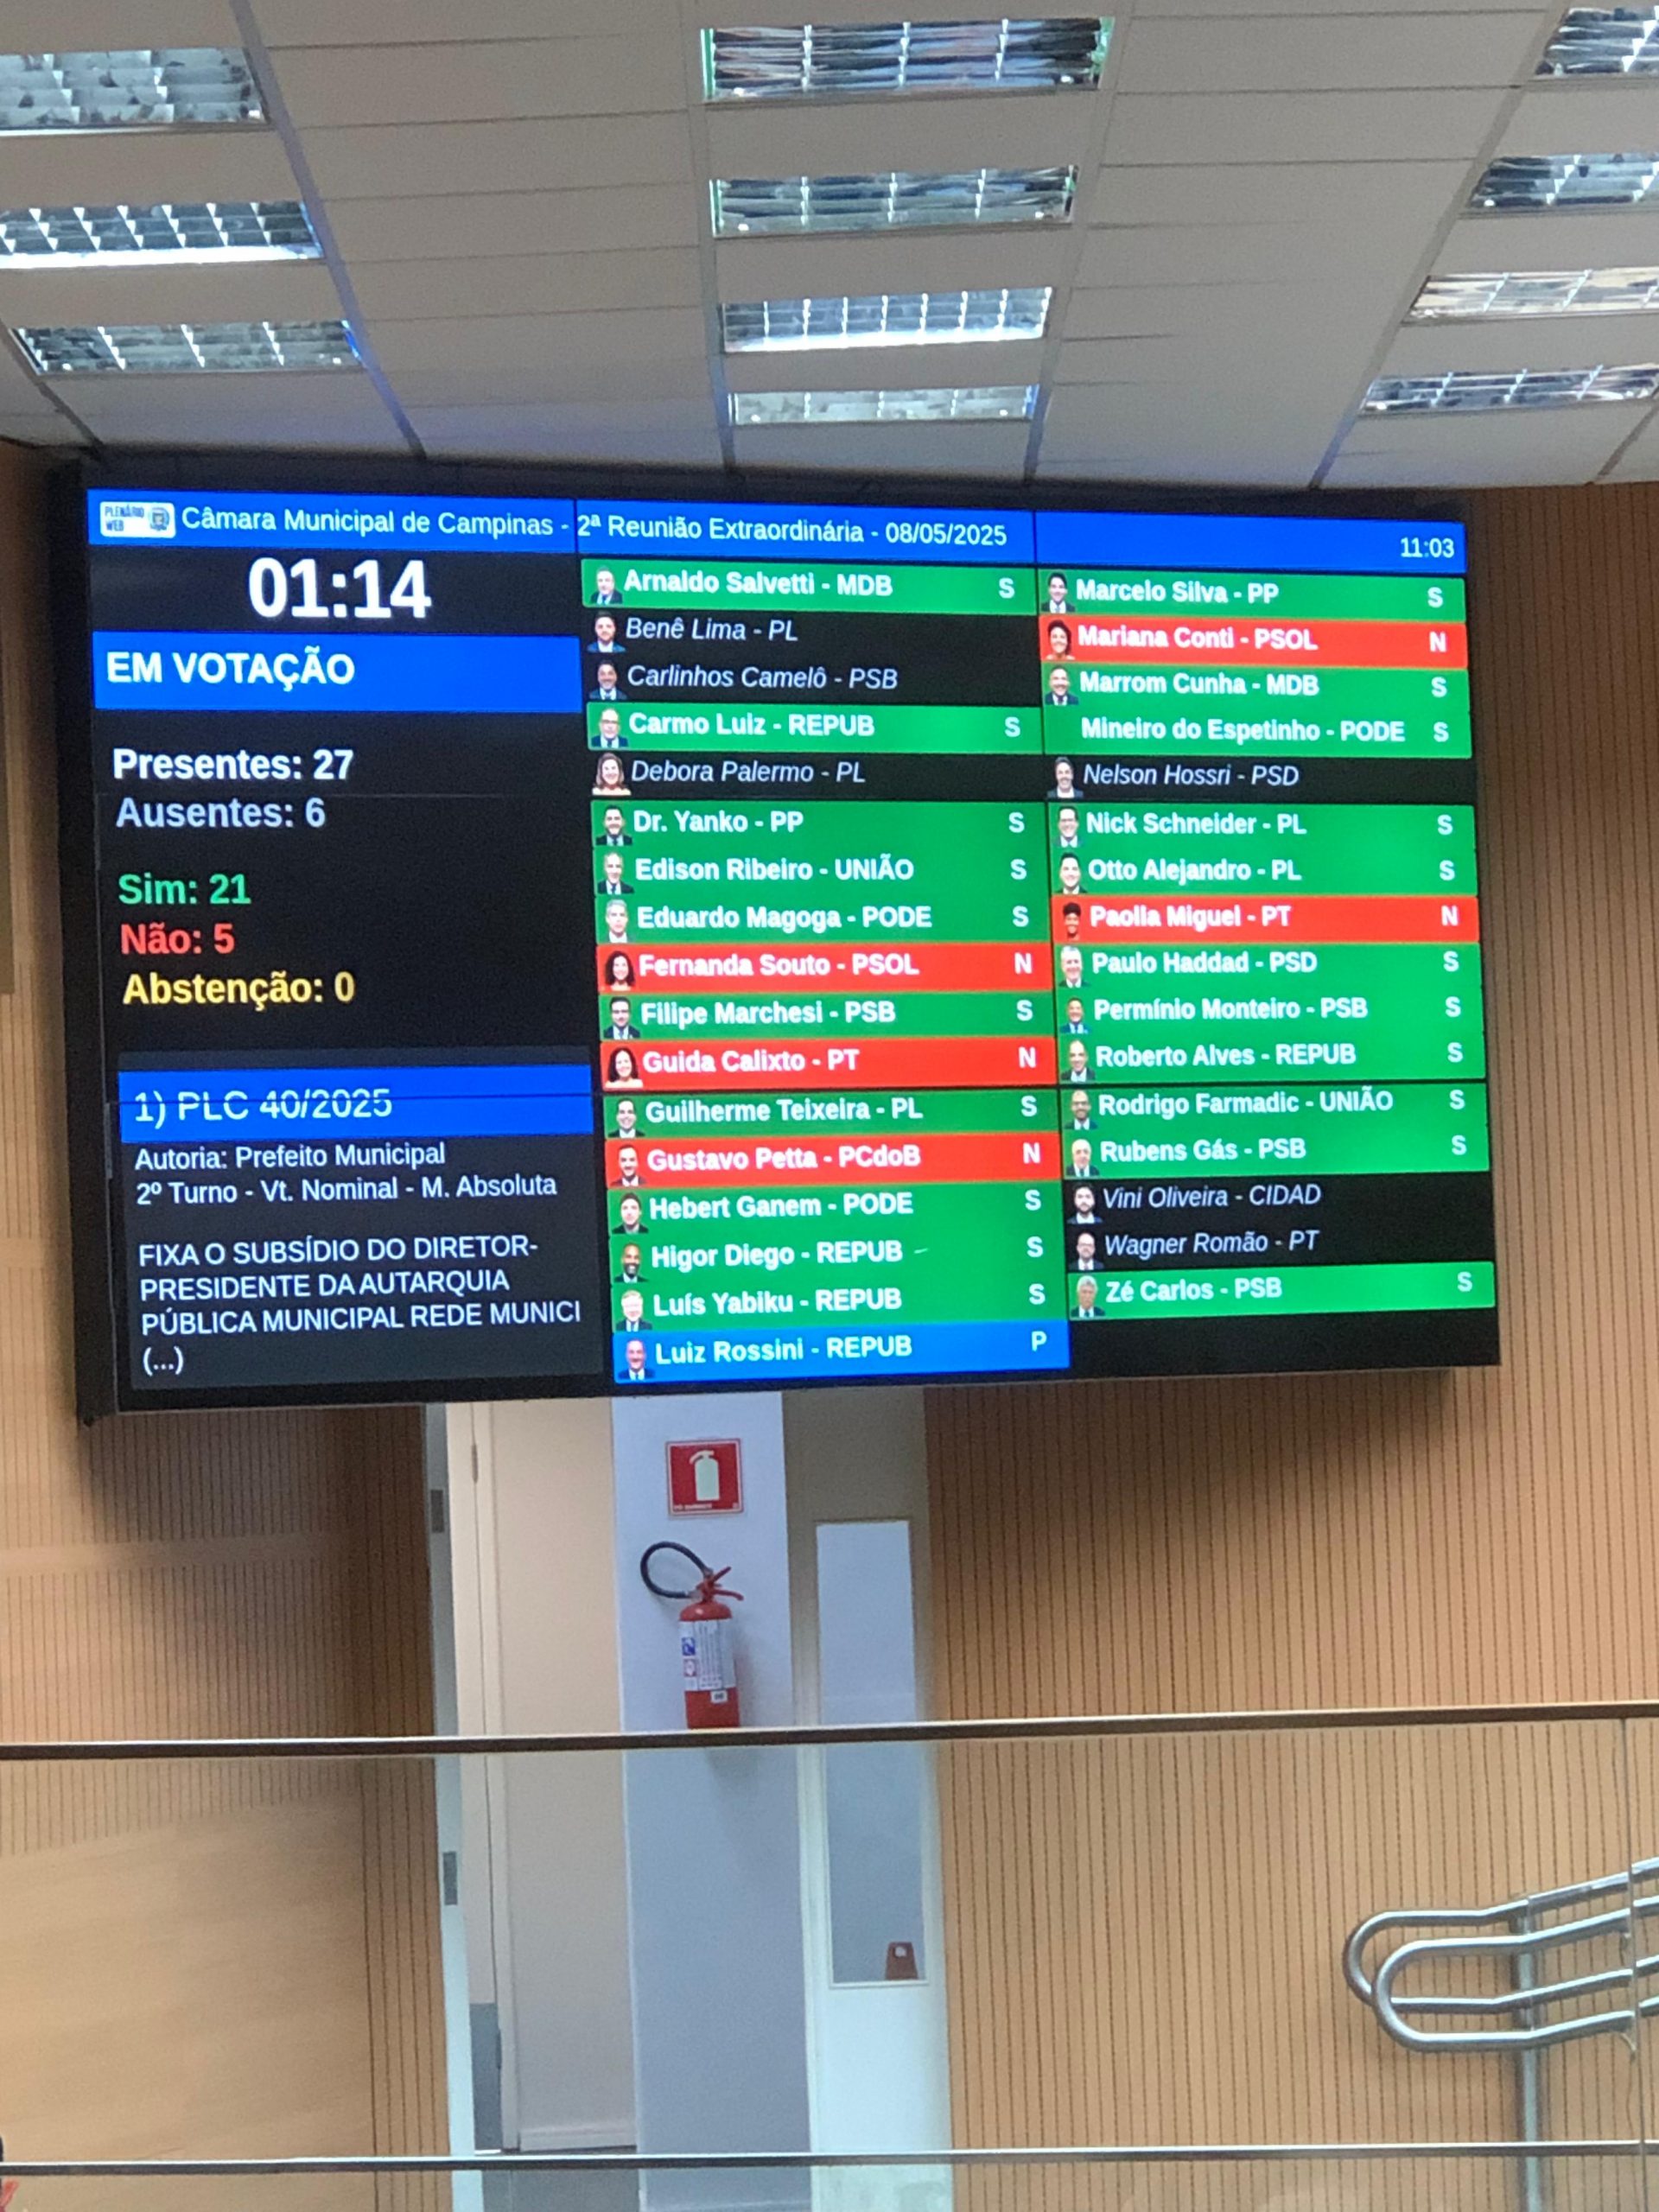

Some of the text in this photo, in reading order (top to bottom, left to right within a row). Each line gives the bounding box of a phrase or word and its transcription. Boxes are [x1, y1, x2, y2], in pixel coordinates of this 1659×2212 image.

[182, 507, 276, 530] Câmara
[285, 509, 394, 537] Municipal
[403, 512, 429, 532] de
[439, 512, 553, 539] Campinas
[608, 515, 702, 538] Reunião
[709, 518, 864, 542] Extraordinária
[886, 523, 1007, 545] 08/05/2025
[1402, 537, 1454, 557] 11:03
[250, 558, 431, 618] 01:14
[625, 569, 893, 595] Arnaldo Salvetti MDB
[1077, 579, 1279, 603] Marcelo Silva PP
[626, 617, 798, 640] Benê Lima PL
[1078, 625, 1318, 650] Mariana Conti PSOL
[108, 646, 354, 691] EM VOTAÇÃO
[628, 664, 897, 689] Carlinhos Camelô PSB
[1080, 671, 1319, 696] Marrom Cunha MDB
[629, 713, 874, 736] Carmo Luiz REPUB
[1082, 717, 1405, 745] Mineiro do Espetinho PODE
[114, 748, 353, 779] Presentes: 27
[632, 760, 865, 782] Debora Palermo PL
[1084, 764, 1299, 785] Nelson Hossri PSD
[117, 798, 325, 827] Ausentes: 6
[634, 810, 803, 832] Dr. Yanko PP
[1087, 812, 1306, 834] Nick Schneider PL
[636, 854, 913, 880] Edison Ribeiro UNIÃO
[1089, 859, 1301, 886] Otto Alejandro PL
[119, 873, 251, 904] Sim: 21
[638, 906, 931, 933] Eduardo Magoga PODE
[1166, 905, 1241, 932] Miguel
[1262, 906, 1291, 926] PT
[122, 923, 234, 954] Não: 5
[639, 953, 919, 976] Fernanda Souto PSOL
[1092, 951, 1317, 973] Paulo Haddad PSD
[124, 970, 354, 1011] Abstenção: 0
[642, 1001, 895, 1030] Filipe Marchesi PSB
[1095, 997, 1368, 1020] Permínio Monteiro PSB
[643, 1049, 860, 1073] Guida Calixto PT
[1096, 1044, 1356, 1066] Roberto Alves REPUB
[136, 1089, 391, 1128] 1) PLC 40/2025
[646, 1097, 923, 1122] Guilherme Teixeira PL
[1099, 1085, 1393, 1120] Rodrigo Farmadic UNIÃO
[136, 1141, 445, 1170] Autoria: Prefeito Municipal
[647, 1144, 920, 1171] Gustavo Petta PCdoB
[1101, 1138, 1306, 1161] Rubens Gás PSB
[168, 1182, 238, 1204] Turno
[260, 1180, 293, 1202] Vt.
[302, 1176, 397, 1200] Nominal
[422, 1176, 449, 1198] M.
[456, 1173, 557, 1197] Absoluta
[1103, 1184, 1321, 1208] Vini Oliveira CIDAD
[650, 1192, 912, 1219] Hebert Ganem PODE
[140, 1235, 537, 1267] FIXA O SUBSÍDIO DO DIRETOR-
[652, 1240, 902, 1273] Higor Diego REPUB
[1106, 1230, 1319, 1260] Wagner Romão PT
[141, 1269, 510, 1300] PRESIDENTE DA AUTARQUIA
[1106, 1277, 1281, 1302] Zé Carlos PSB
[654, 1287, 901, 1316] Luís Yabiku REPUB
[143, 1301, 580, 1335] PÚBLICA MUNICIPAL REDE MUNICI
[656, 1336, 912, 1363] Luiz Rossini REPUB
[1032, 1332, 1046, 1351] P
[143, 1346, 183, 1376] (...)
